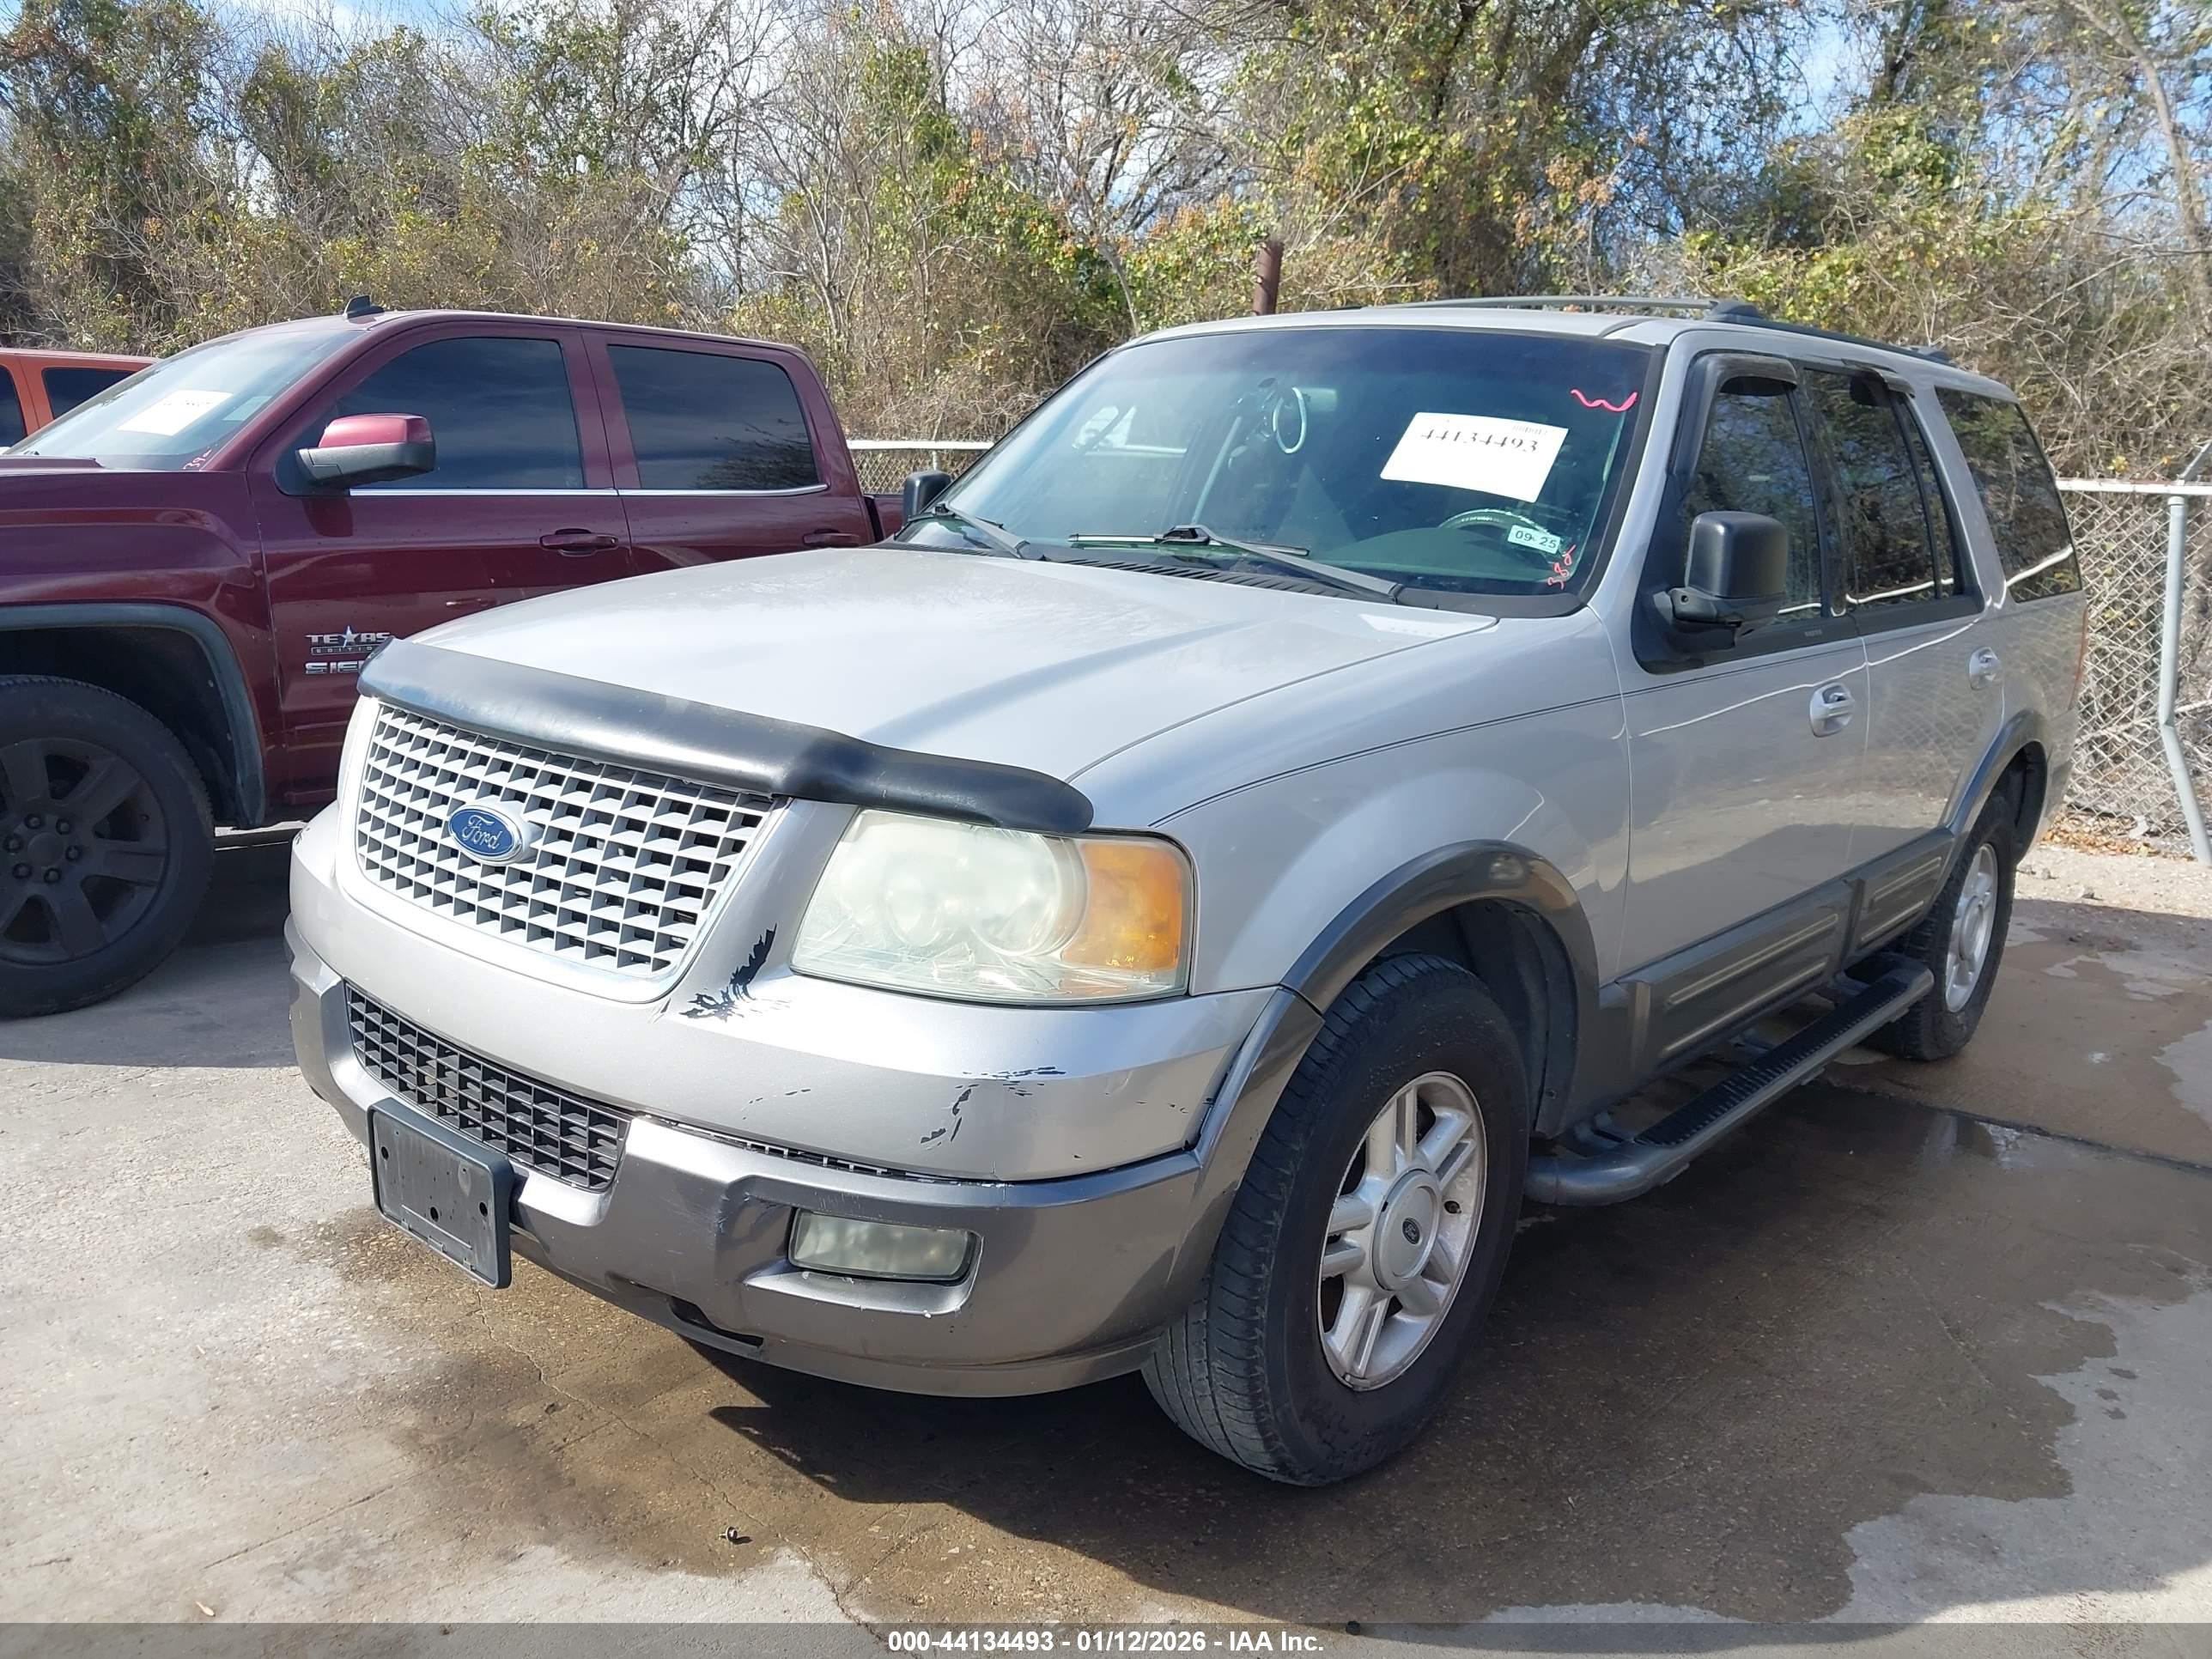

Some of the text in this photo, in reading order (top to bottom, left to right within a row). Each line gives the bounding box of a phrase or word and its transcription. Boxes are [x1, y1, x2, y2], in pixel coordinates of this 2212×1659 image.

[1420, 429, 1538, 453] 44134493
[305, 628, 391, 645] TEXAS
[315, 645, 373, 653] EDITIO
[461, 814, 503, 850] Ford
